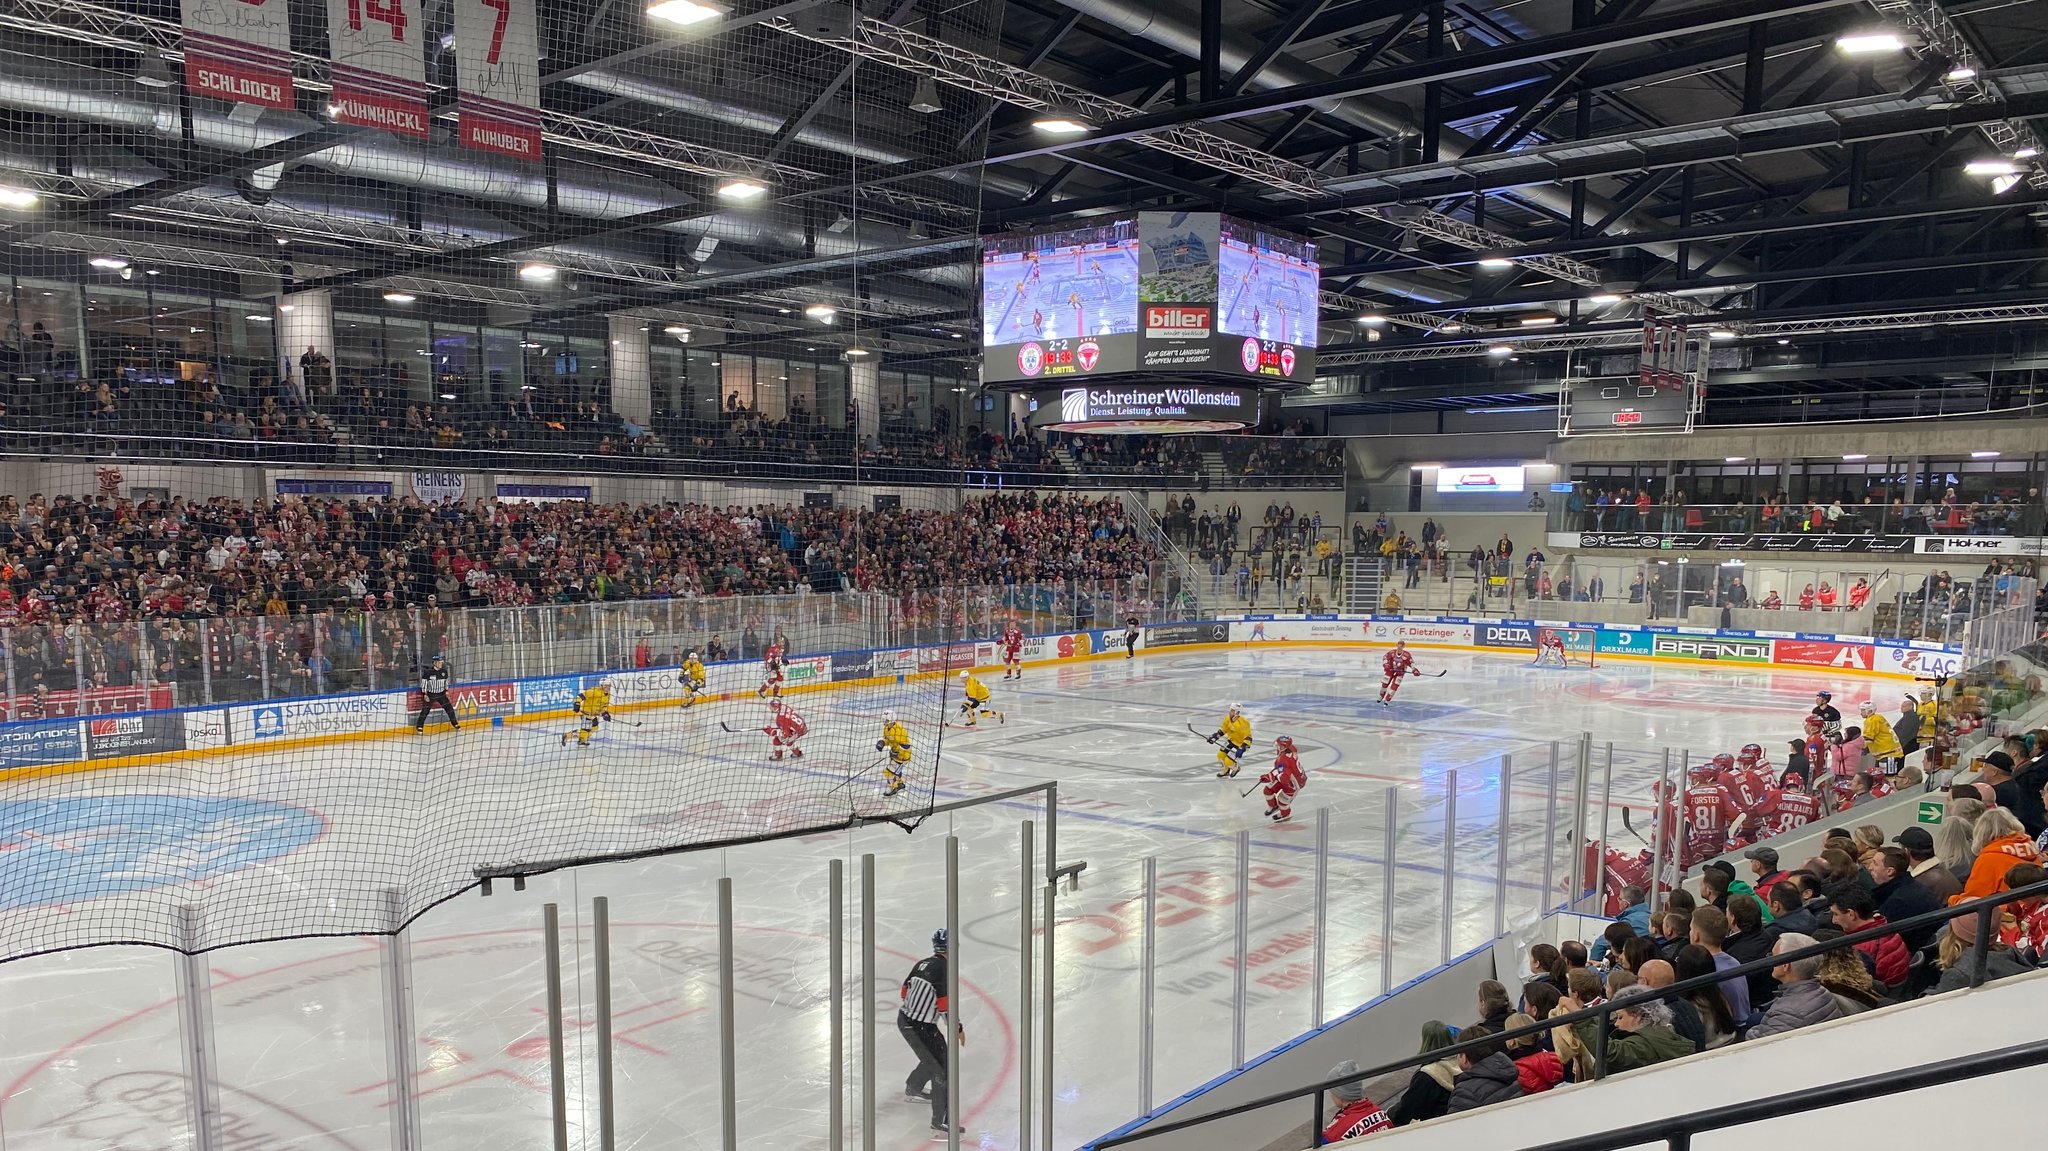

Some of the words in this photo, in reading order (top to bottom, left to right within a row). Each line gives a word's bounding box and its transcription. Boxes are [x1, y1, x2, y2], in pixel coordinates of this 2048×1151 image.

[198, 69, 281, 102] SCHLODER
[338, 99, 424, 131] KÜHNHACKL
[472, 127, 529, 153] AUHUBER
[1149, 310, 1207, 327] biller
[1643, 327, 1654, 353] 39
[1090, 408, 1116, 416] Dienst.
[1118, 406, 1152, 416] Leistung.
[1154, 406, 1187, 415] Qualität.
[416, 472, 462, 486] REINERS
[1409, 628, 1455, 638] Dietzinger
[1487, 628, 1532, 642] DELTA
[1601, 646, 1649, 655] DRÄXLMAIER
[1660, 641, 1770, 658] BRANDL
[524, 688, 574, 707] NEWS
[286, 698, 388, 718] STADTWERKE
[287, 714, 373, 734] LANDSHUT
[1695, 806, 1716, 830] 81
[1344, 1114, 1379, 1140] WADLE
